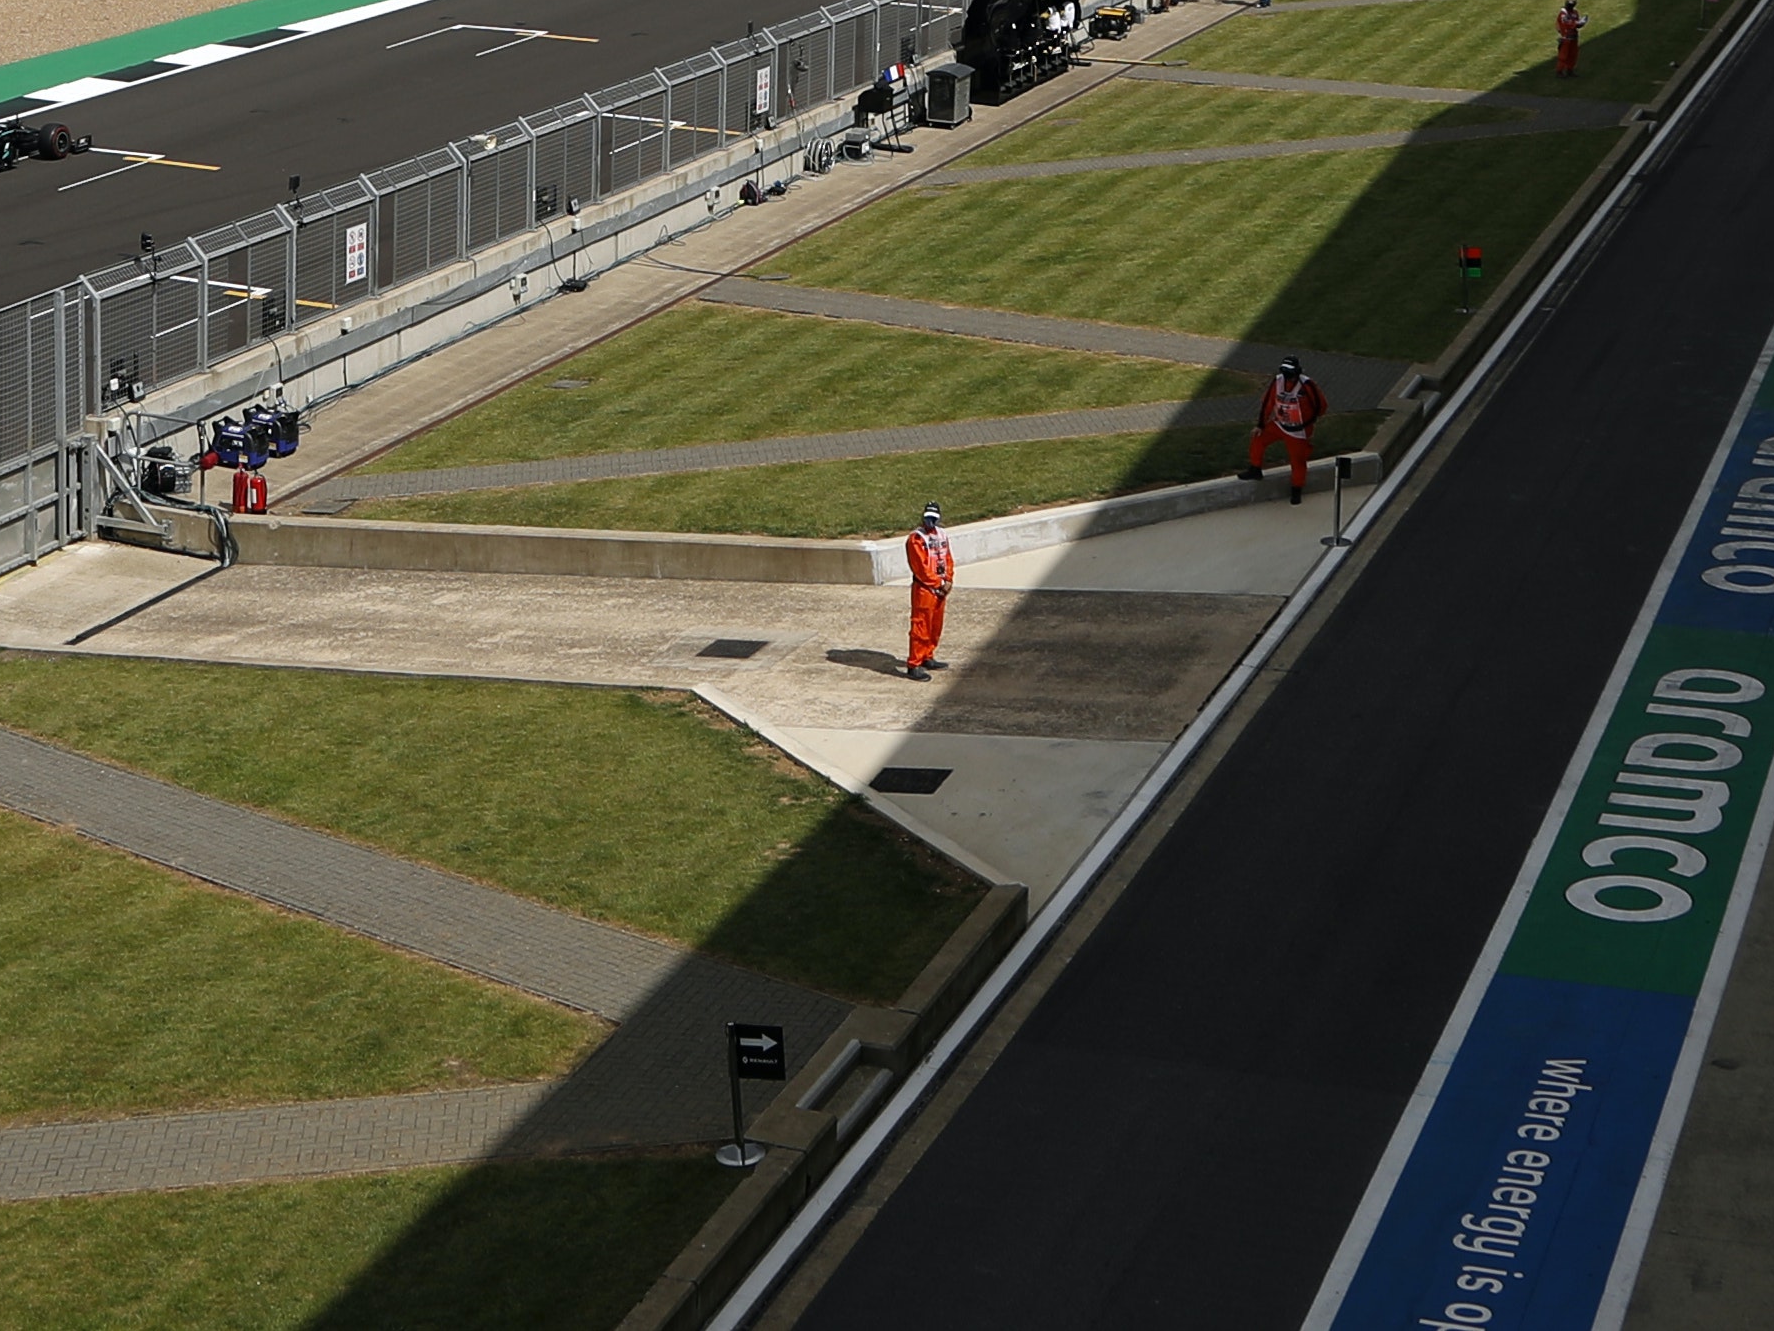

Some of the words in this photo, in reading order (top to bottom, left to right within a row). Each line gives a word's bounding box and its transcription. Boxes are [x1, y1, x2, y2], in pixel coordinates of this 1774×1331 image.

[1565, 668, 1765, 922] aramco
[1516, 1059, 1594, 1142] where
[1452, 1149, 1552, 1259] energy
[1456, 1265, 1525, 1294] is
